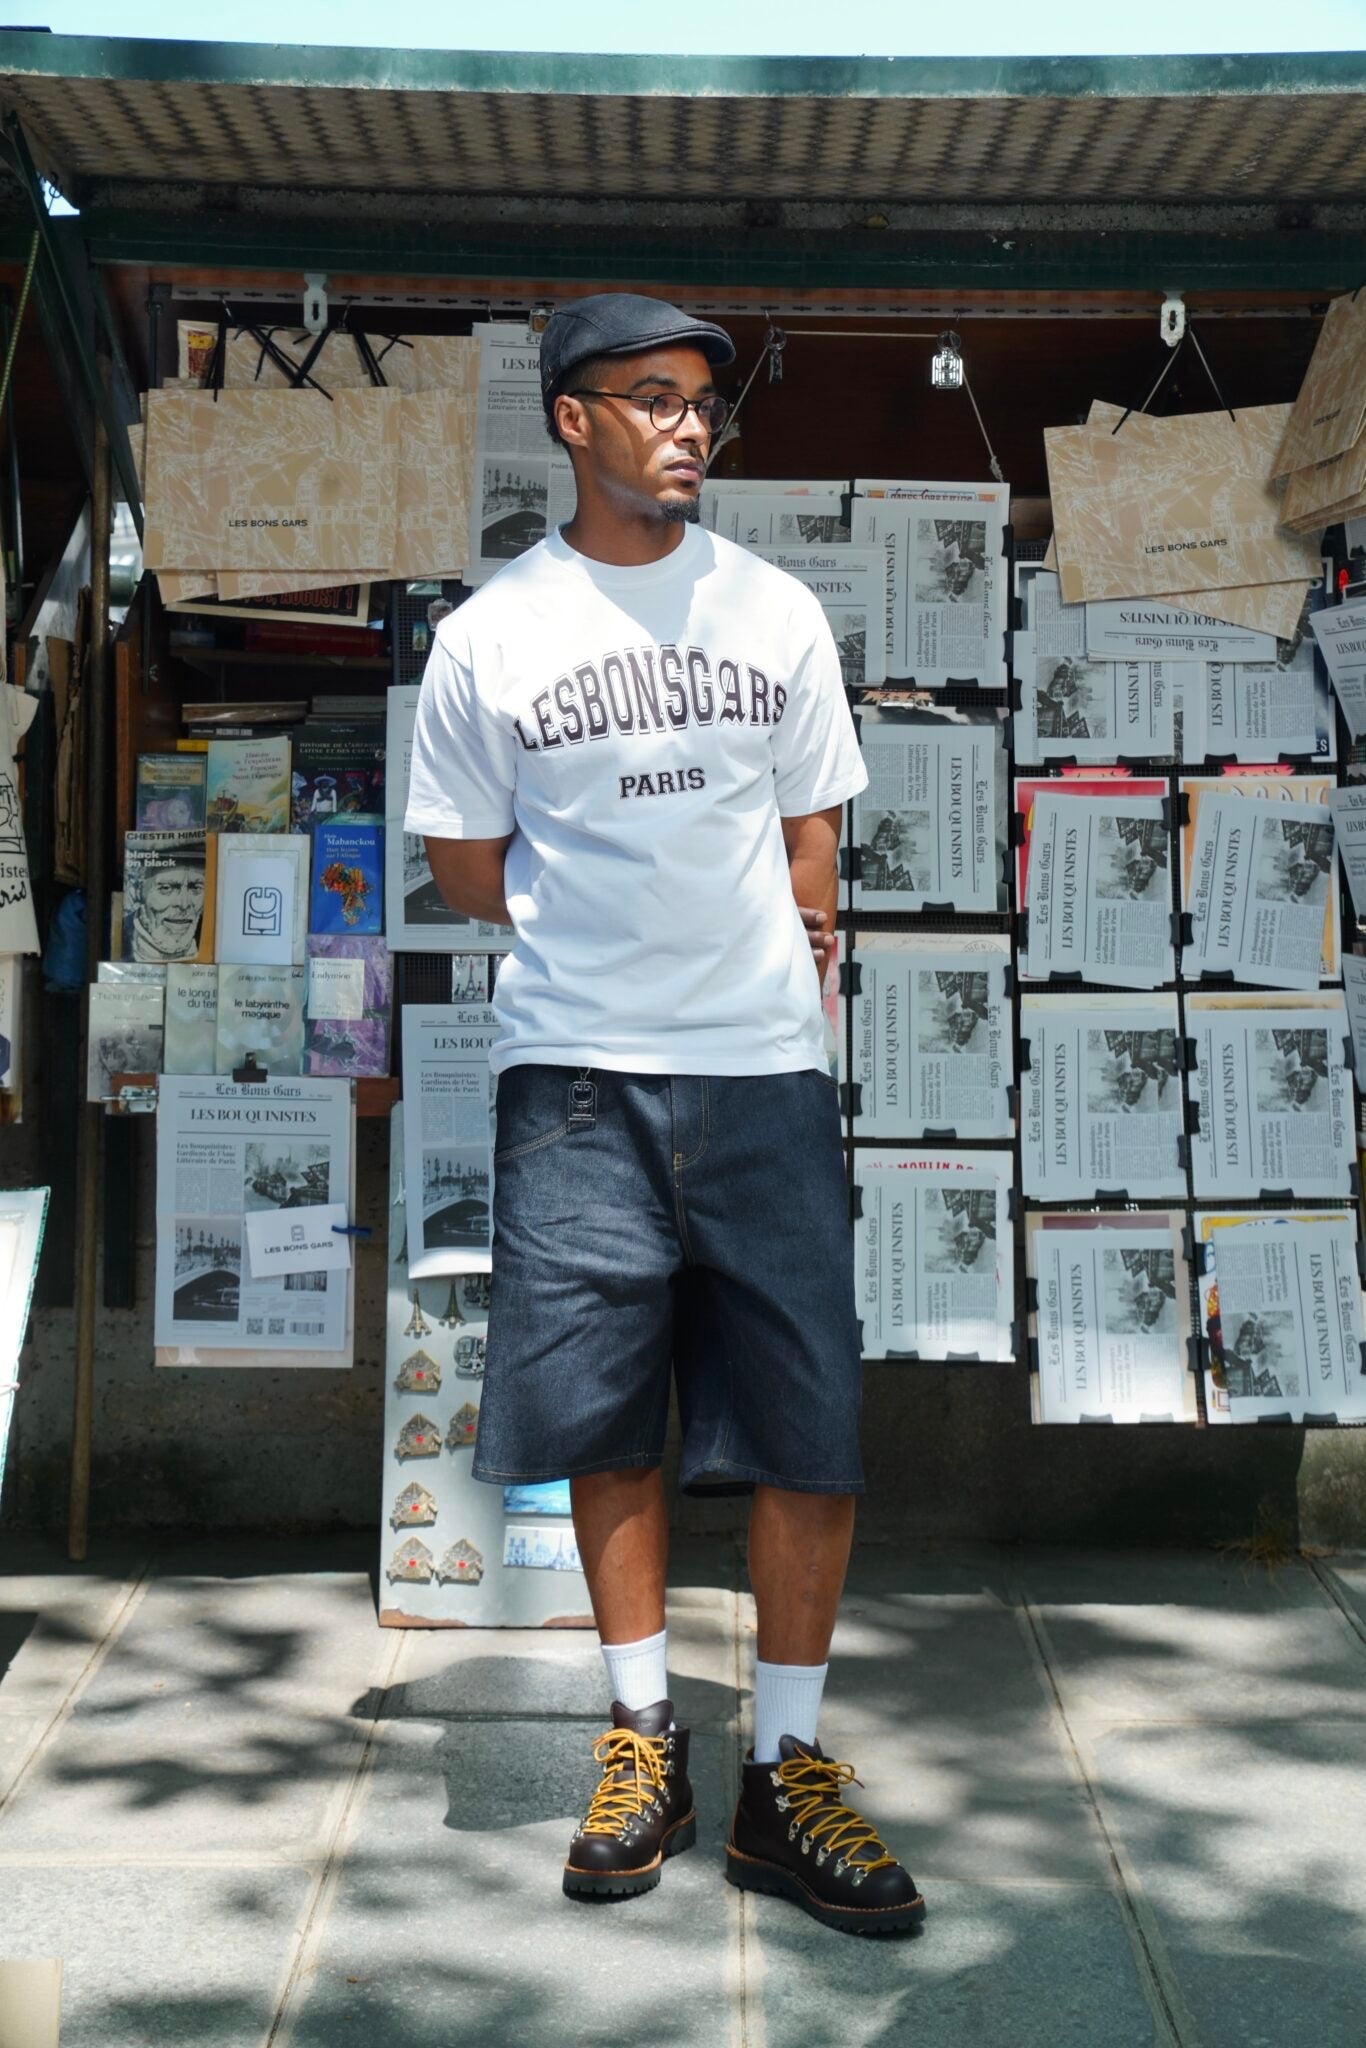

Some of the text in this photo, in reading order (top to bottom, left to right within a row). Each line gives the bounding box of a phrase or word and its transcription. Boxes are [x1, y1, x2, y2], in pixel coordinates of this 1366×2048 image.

[502, 358, 525, 370] LES
[1145, 539, 1228, 554] LES BONS GARS
[777, 556, 836, 568] Bons Gars
[885, 533, 897, 654] LES BOUQUINISTES
[1135, 637, 1218, 652] Les Bons Gars
[1212, 704, 1223, 726] LES
[619, 767, 707, 799] PARIS
[949, 757, 962, 878] LES BOUQUINISTES
[976, 780, 987, 863] Les Bons Gars
[127, 830, 206, 841] CHESTER HIMES
[327, 838, 375, 846] Mabanckou
[126, 851, 159, 859] black
[126, 858, 176, 868] on black
[1037, 843, 1051, 925] Les Bons Gars
[1062, 828, 1077, 948] LES BOUQUINISTES
[1218, 828, 1241, 947] LES BOUQUINISTES
[178, 988, 211, 1000] le long
[188, 999, 200, 1008] du
[234, 999, 290, 1010] le labyrinthe
[242, 1010, 281, 1019] magique
[458, 1011, 478, 1023] Les
[434, 1038, 457, 1049] LES
[860, 1000, 872, 1083] Les Bons Gars
[886, 984, 899, 1106] LES BOUQUINISTES
[989, 1006, 1002, 1088] Les Bons Gars
[216, 1083, 237, 1095] Les
[241, 1084, 270, 1096] Bons
[273, 1085, 301, 1097] Gars
[1029, 1058, 1040, 1142] Les Bons Gars
[1055, 1043, 1068, 1165] LES BOUQUINISTES
[191, 1109, 317, 1123] LES BOUQUINISTES
[1222, 1044, 1239, 1166] LES BOUQUINISTES
[1331, 1064, 1345, 1148] Les Bons Gars
[310, 1242, 333, 1250] GARS
[865, 1217, 878, 1303] Les Bons Gars
[891, 1203, 905, 1327] LES BOUQUINISTES
[1046, 1280, 1057, 1308] Gars
[1070, 1264, 1087, 1390] LES BOUQUINISTES
[1310, 1254, 1332, 1380] LES BOUQUINISTES
